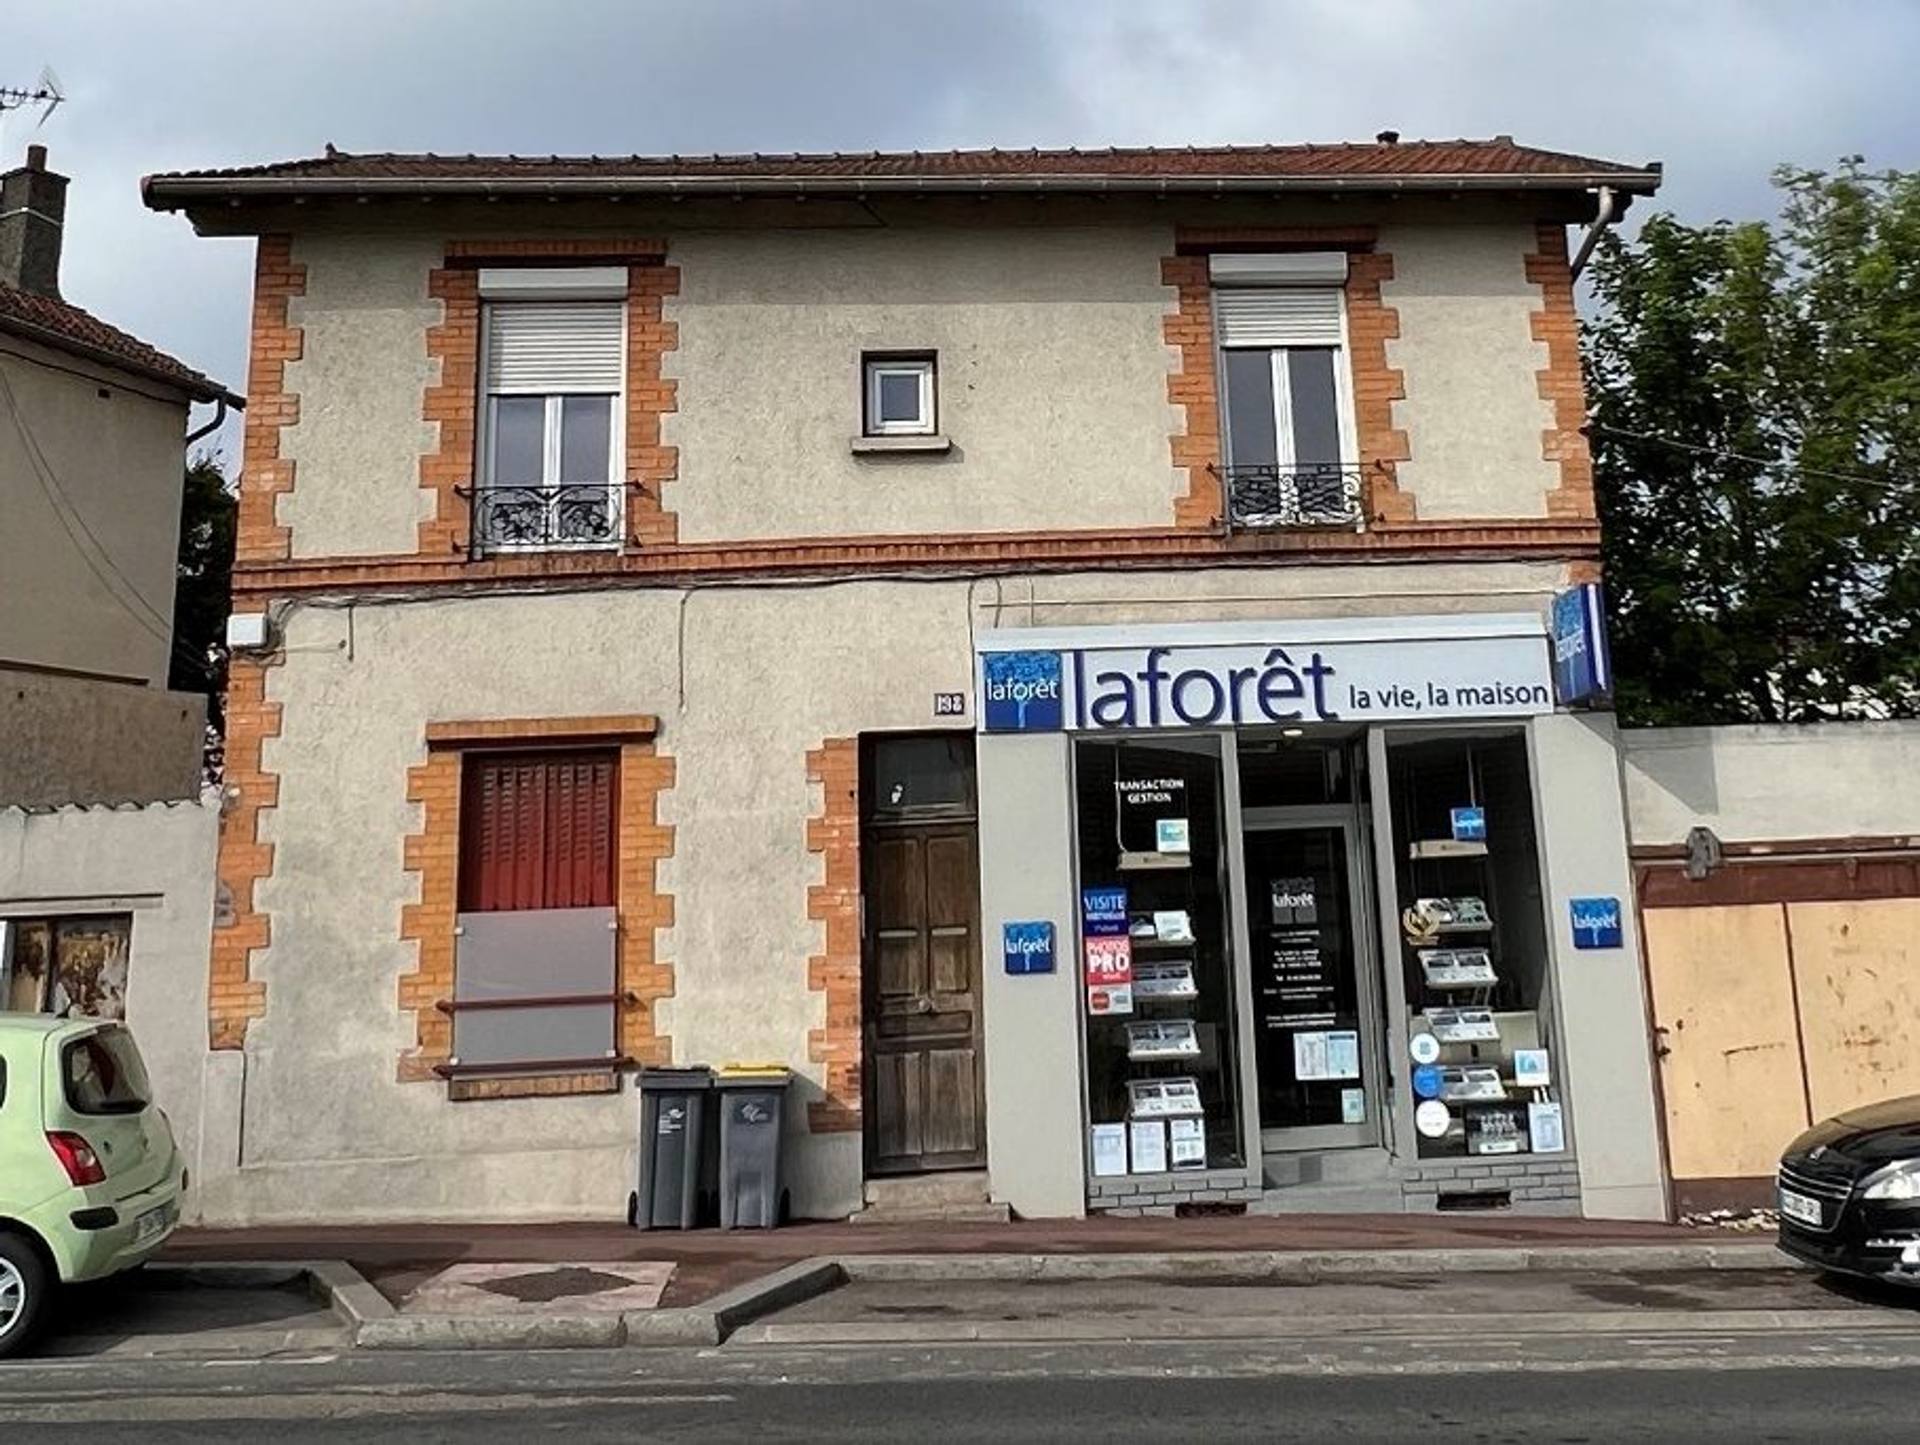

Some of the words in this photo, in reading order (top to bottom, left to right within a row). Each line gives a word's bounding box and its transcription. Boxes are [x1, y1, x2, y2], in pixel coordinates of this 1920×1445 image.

[986, 676, 1059, 702] laforêt
[1072, 648, 1339, 728] laforêt
[1350, 685, 1371, 708] la
[1377, 684, 1422, 711] vie,
[1427, 682, 1449, 706] la
[1456, 681, 1547, 706] maison
[1113, 779, 1184, 791] TRANSACTION
[1083, 895, 1125, 911] VISITE
[1089, 953, 1129, 973] PRO
